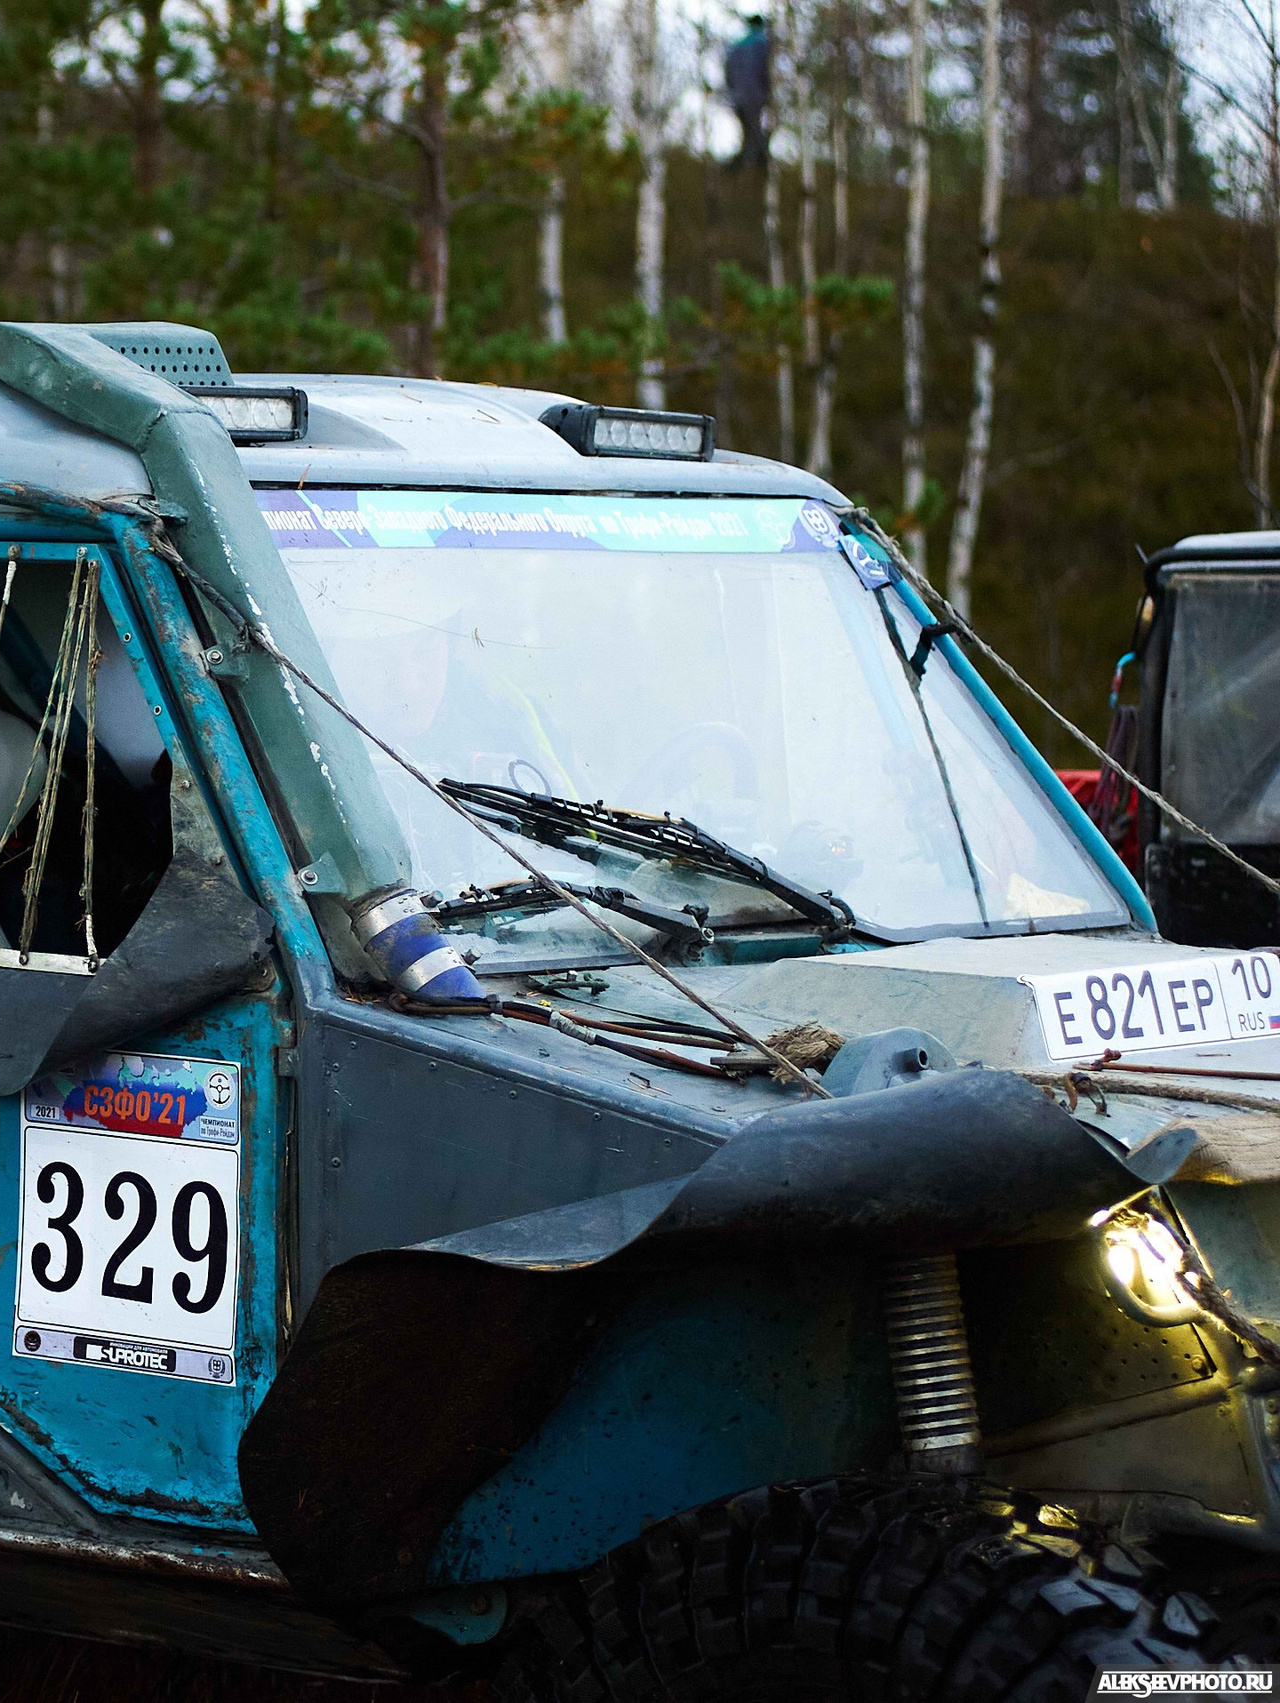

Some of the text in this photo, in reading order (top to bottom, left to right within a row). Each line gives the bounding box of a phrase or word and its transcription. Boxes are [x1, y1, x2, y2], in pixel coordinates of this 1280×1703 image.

[312, 503, 449, 535] Северо-Западного
[444, 504, 550, 536] Федерального
[543, 507, 598, 538] Округа
[710, 512, 750, 537] 2021
[1231, 956, 1272, 1000] 10
[1238, 1011, 1266, 1031] RUS
[35, 1106, 56, 1119] 2021
[84, 1085, 186, 1126] СЗФО'21
[201, 1117, 235, 1128] ЧЕМПИОНАТ
[31, 1161, 228, 1314] 329
[102, 1347, 168, 1370] SUPROTEC
